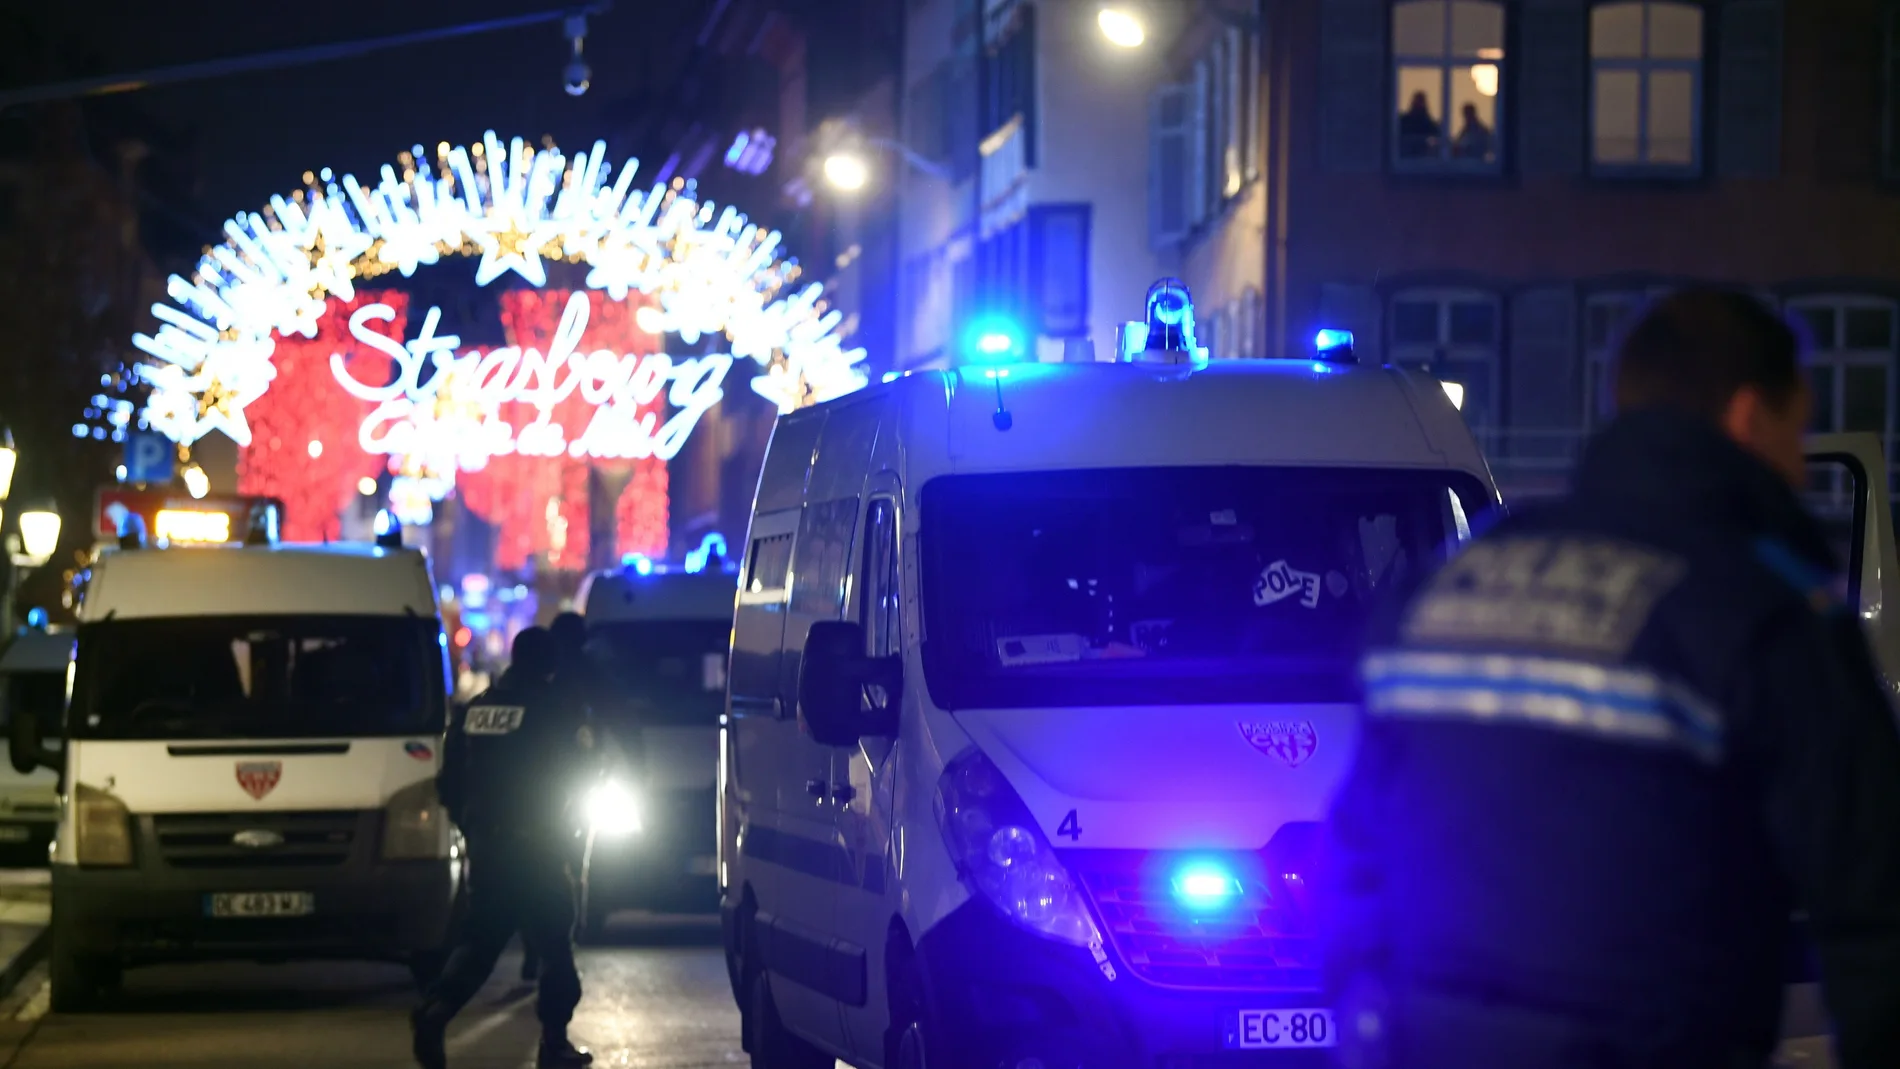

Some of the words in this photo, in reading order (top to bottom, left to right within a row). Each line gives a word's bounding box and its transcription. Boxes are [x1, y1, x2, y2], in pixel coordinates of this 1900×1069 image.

[330, 291, 733, 460] Strasbourg
[136, 434, 164, 475] P
[467, 708, 521, 731] POLICE
[1057, 809, 1082, 841] 4
